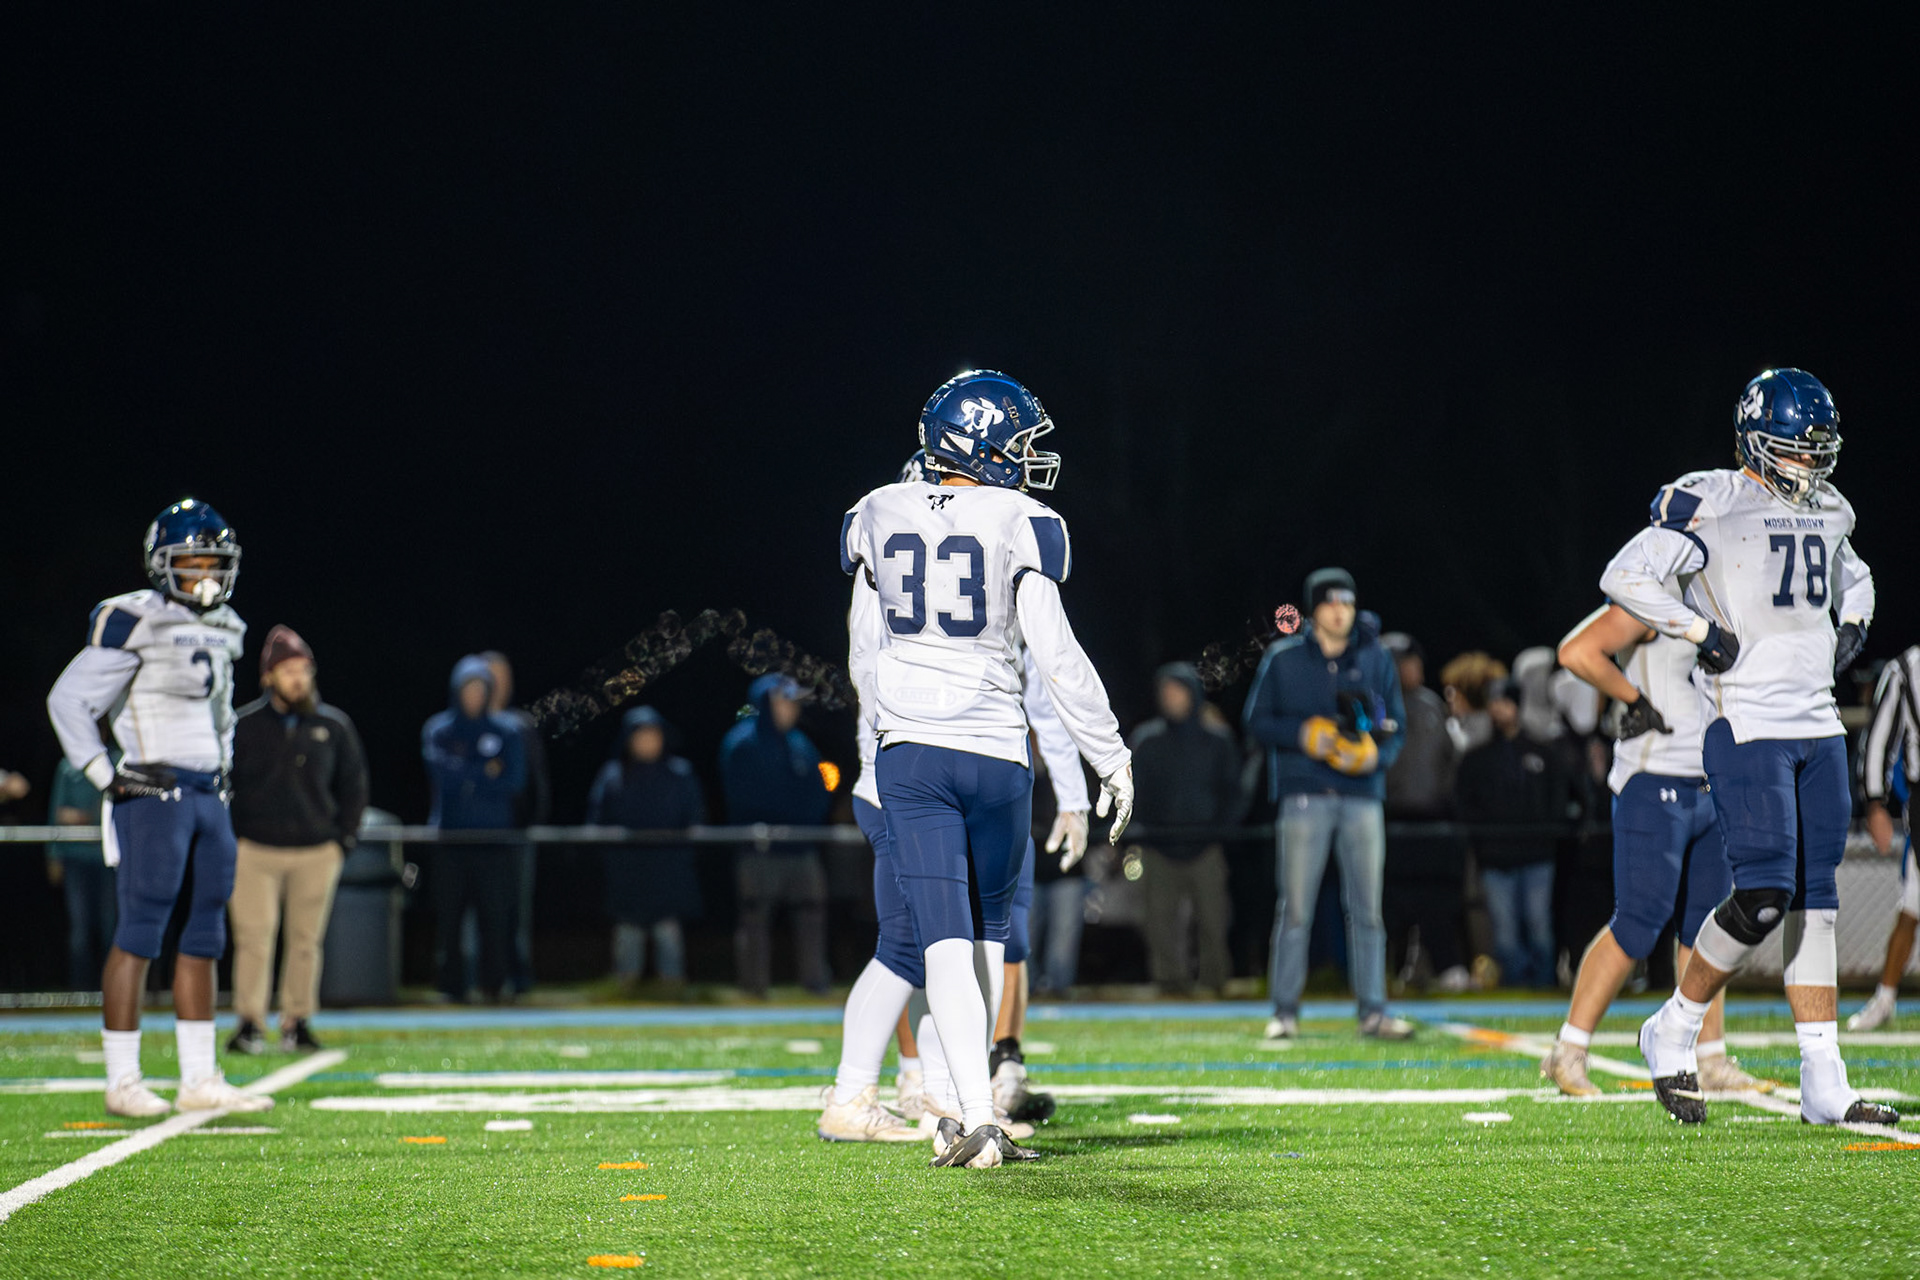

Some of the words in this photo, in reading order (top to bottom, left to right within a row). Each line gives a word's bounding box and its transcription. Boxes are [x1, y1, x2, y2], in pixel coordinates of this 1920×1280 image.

[1763, 517, 1793, 529] MOSES
[1795, 517, 1825, 529] BROWN
[882, 532, 988, 638] 33
[1769, 534, 1828, 607] 78
